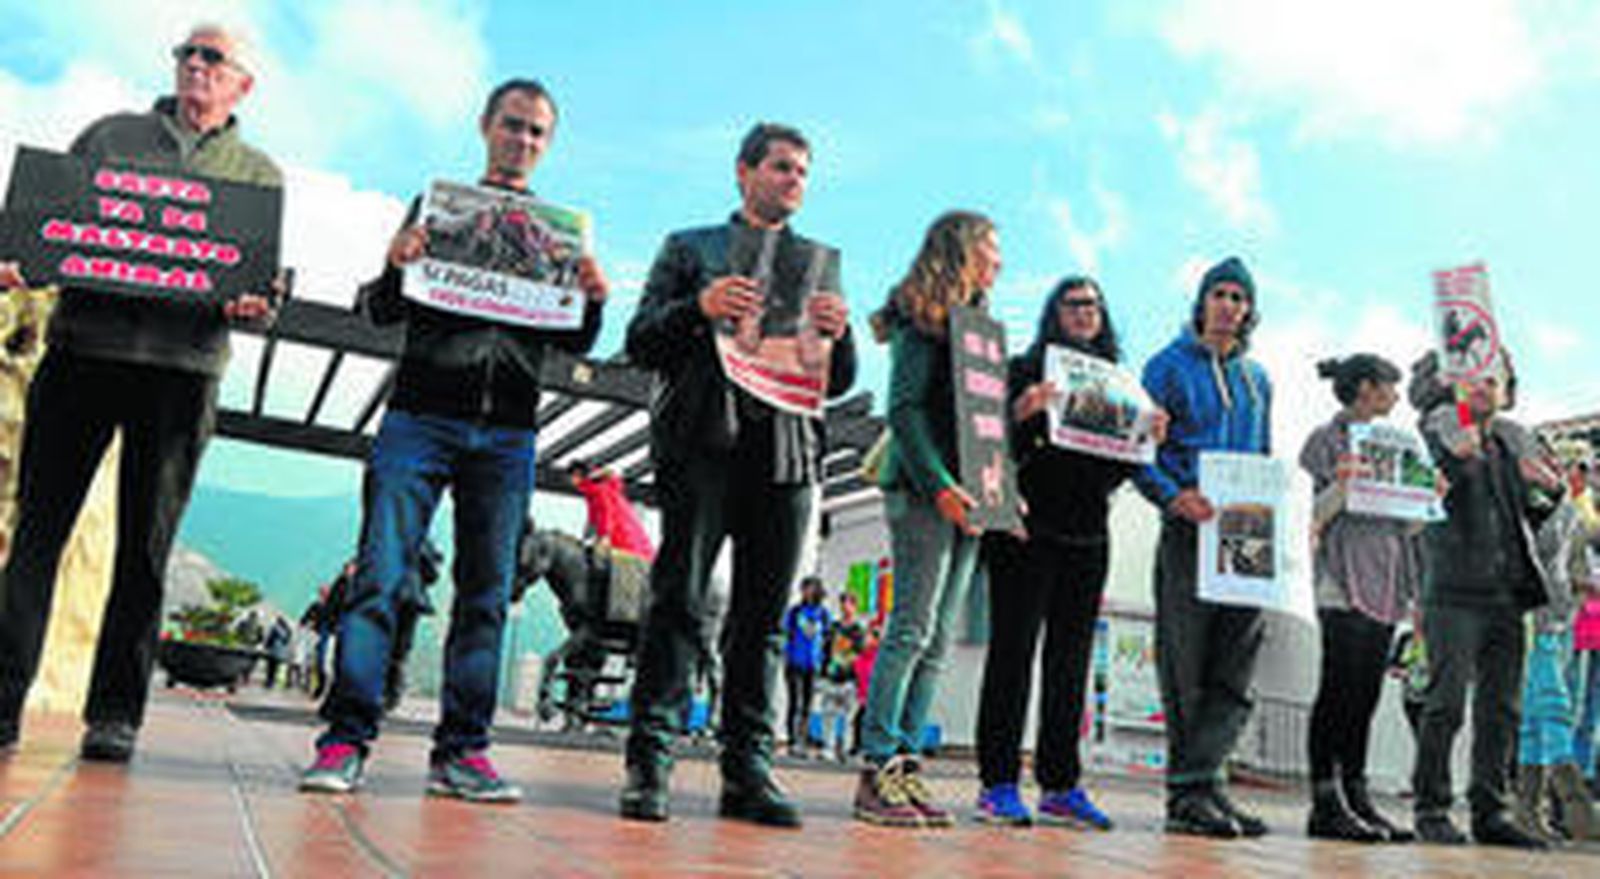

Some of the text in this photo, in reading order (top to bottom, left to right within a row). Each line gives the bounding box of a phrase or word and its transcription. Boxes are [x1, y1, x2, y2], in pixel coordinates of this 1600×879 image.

[95, 169, 212, 202] BASTA
[99, 197, 144, 223] YA
[43, 219, 241, 264] MALTRATO
[60, 254, 212, 291] ANIMAL
